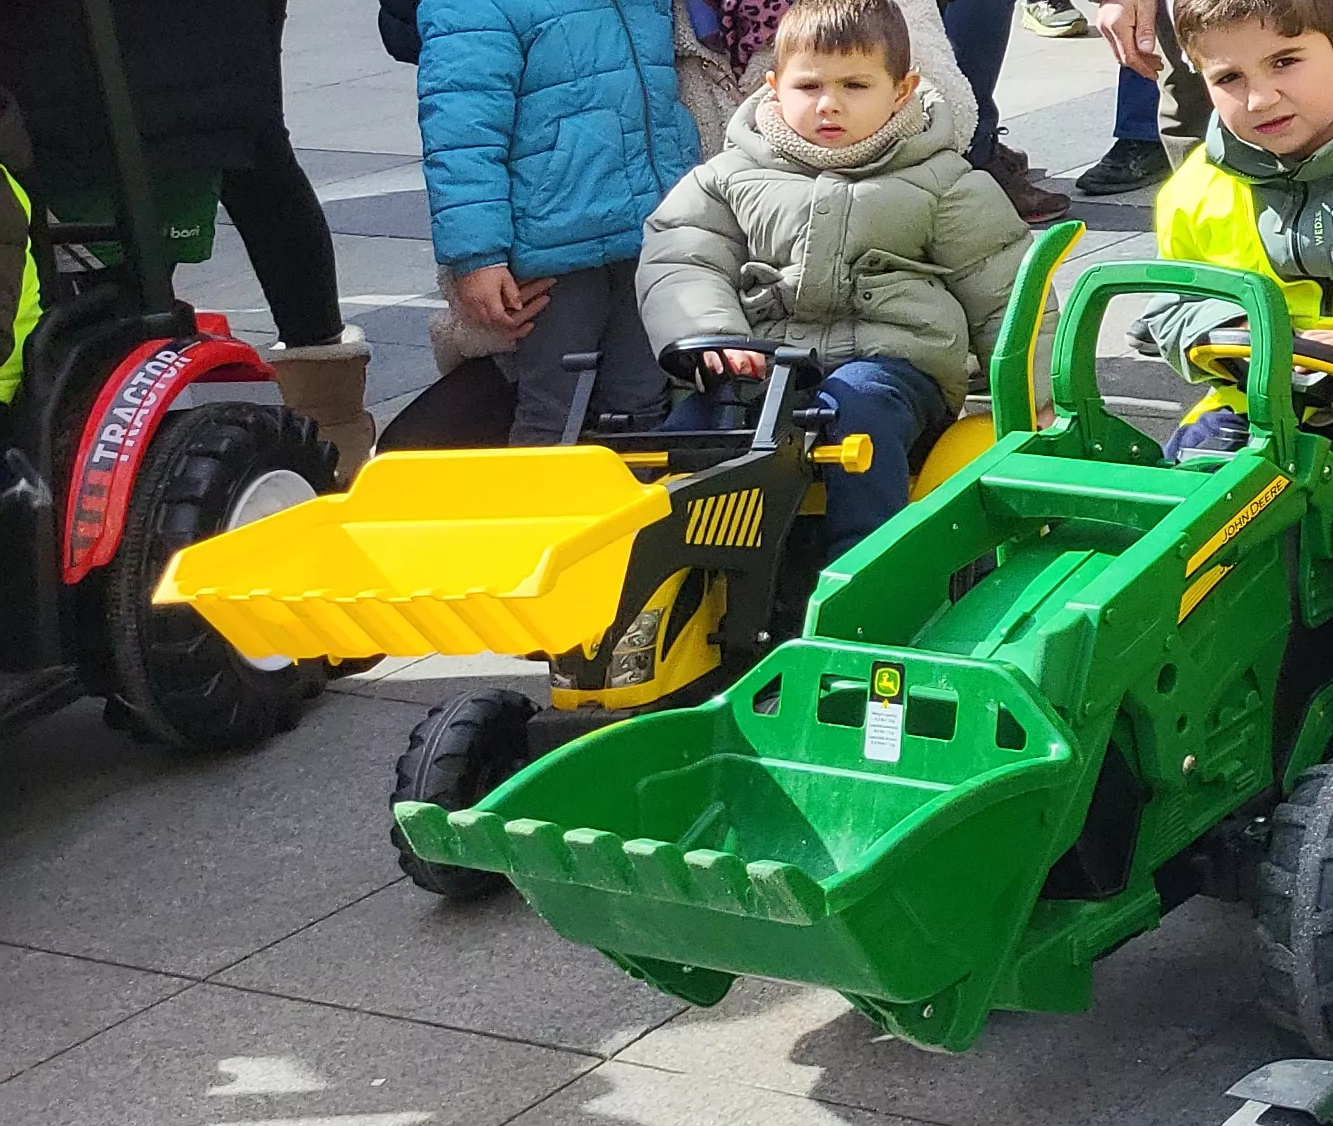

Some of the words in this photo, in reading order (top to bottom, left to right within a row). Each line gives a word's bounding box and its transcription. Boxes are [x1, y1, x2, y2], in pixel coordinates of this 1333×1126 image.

[92, 349, 193, 464] TRACTOR
[1222, 513, 1250, 543] JOHN
[1249, 479, 1284, 516] DEERE
